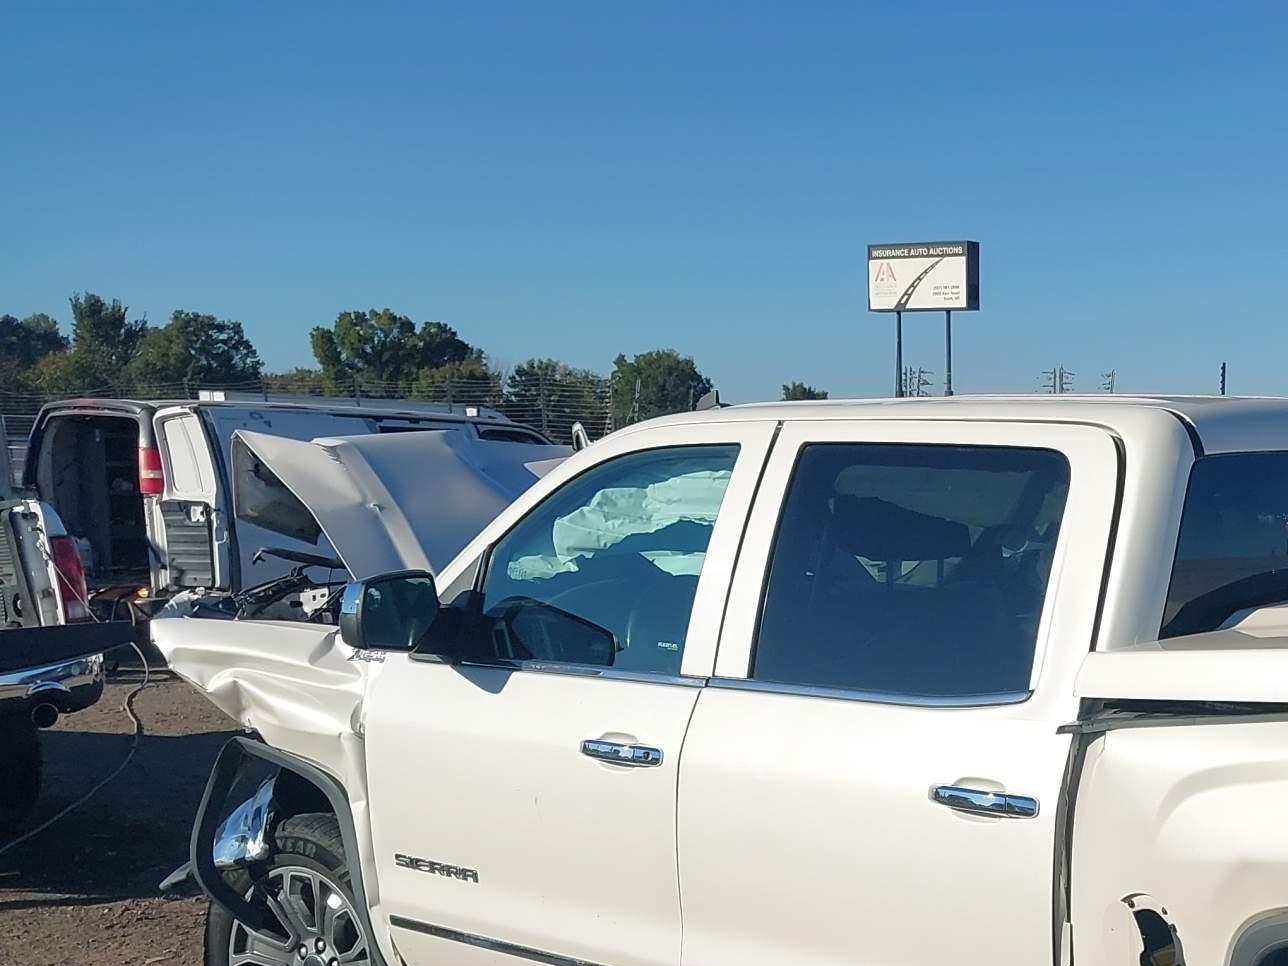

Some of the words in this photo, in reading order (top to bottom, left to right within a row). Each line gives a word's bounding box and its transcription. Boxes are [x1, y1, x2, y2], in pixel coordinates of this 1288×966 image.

[872, 248, 909, 258] INSURANCE
[910, 247, 928, 256] AUTO
[929, 246, 963, 255] AUCTIONS
[394, 853, 479, 883] SIERRA
